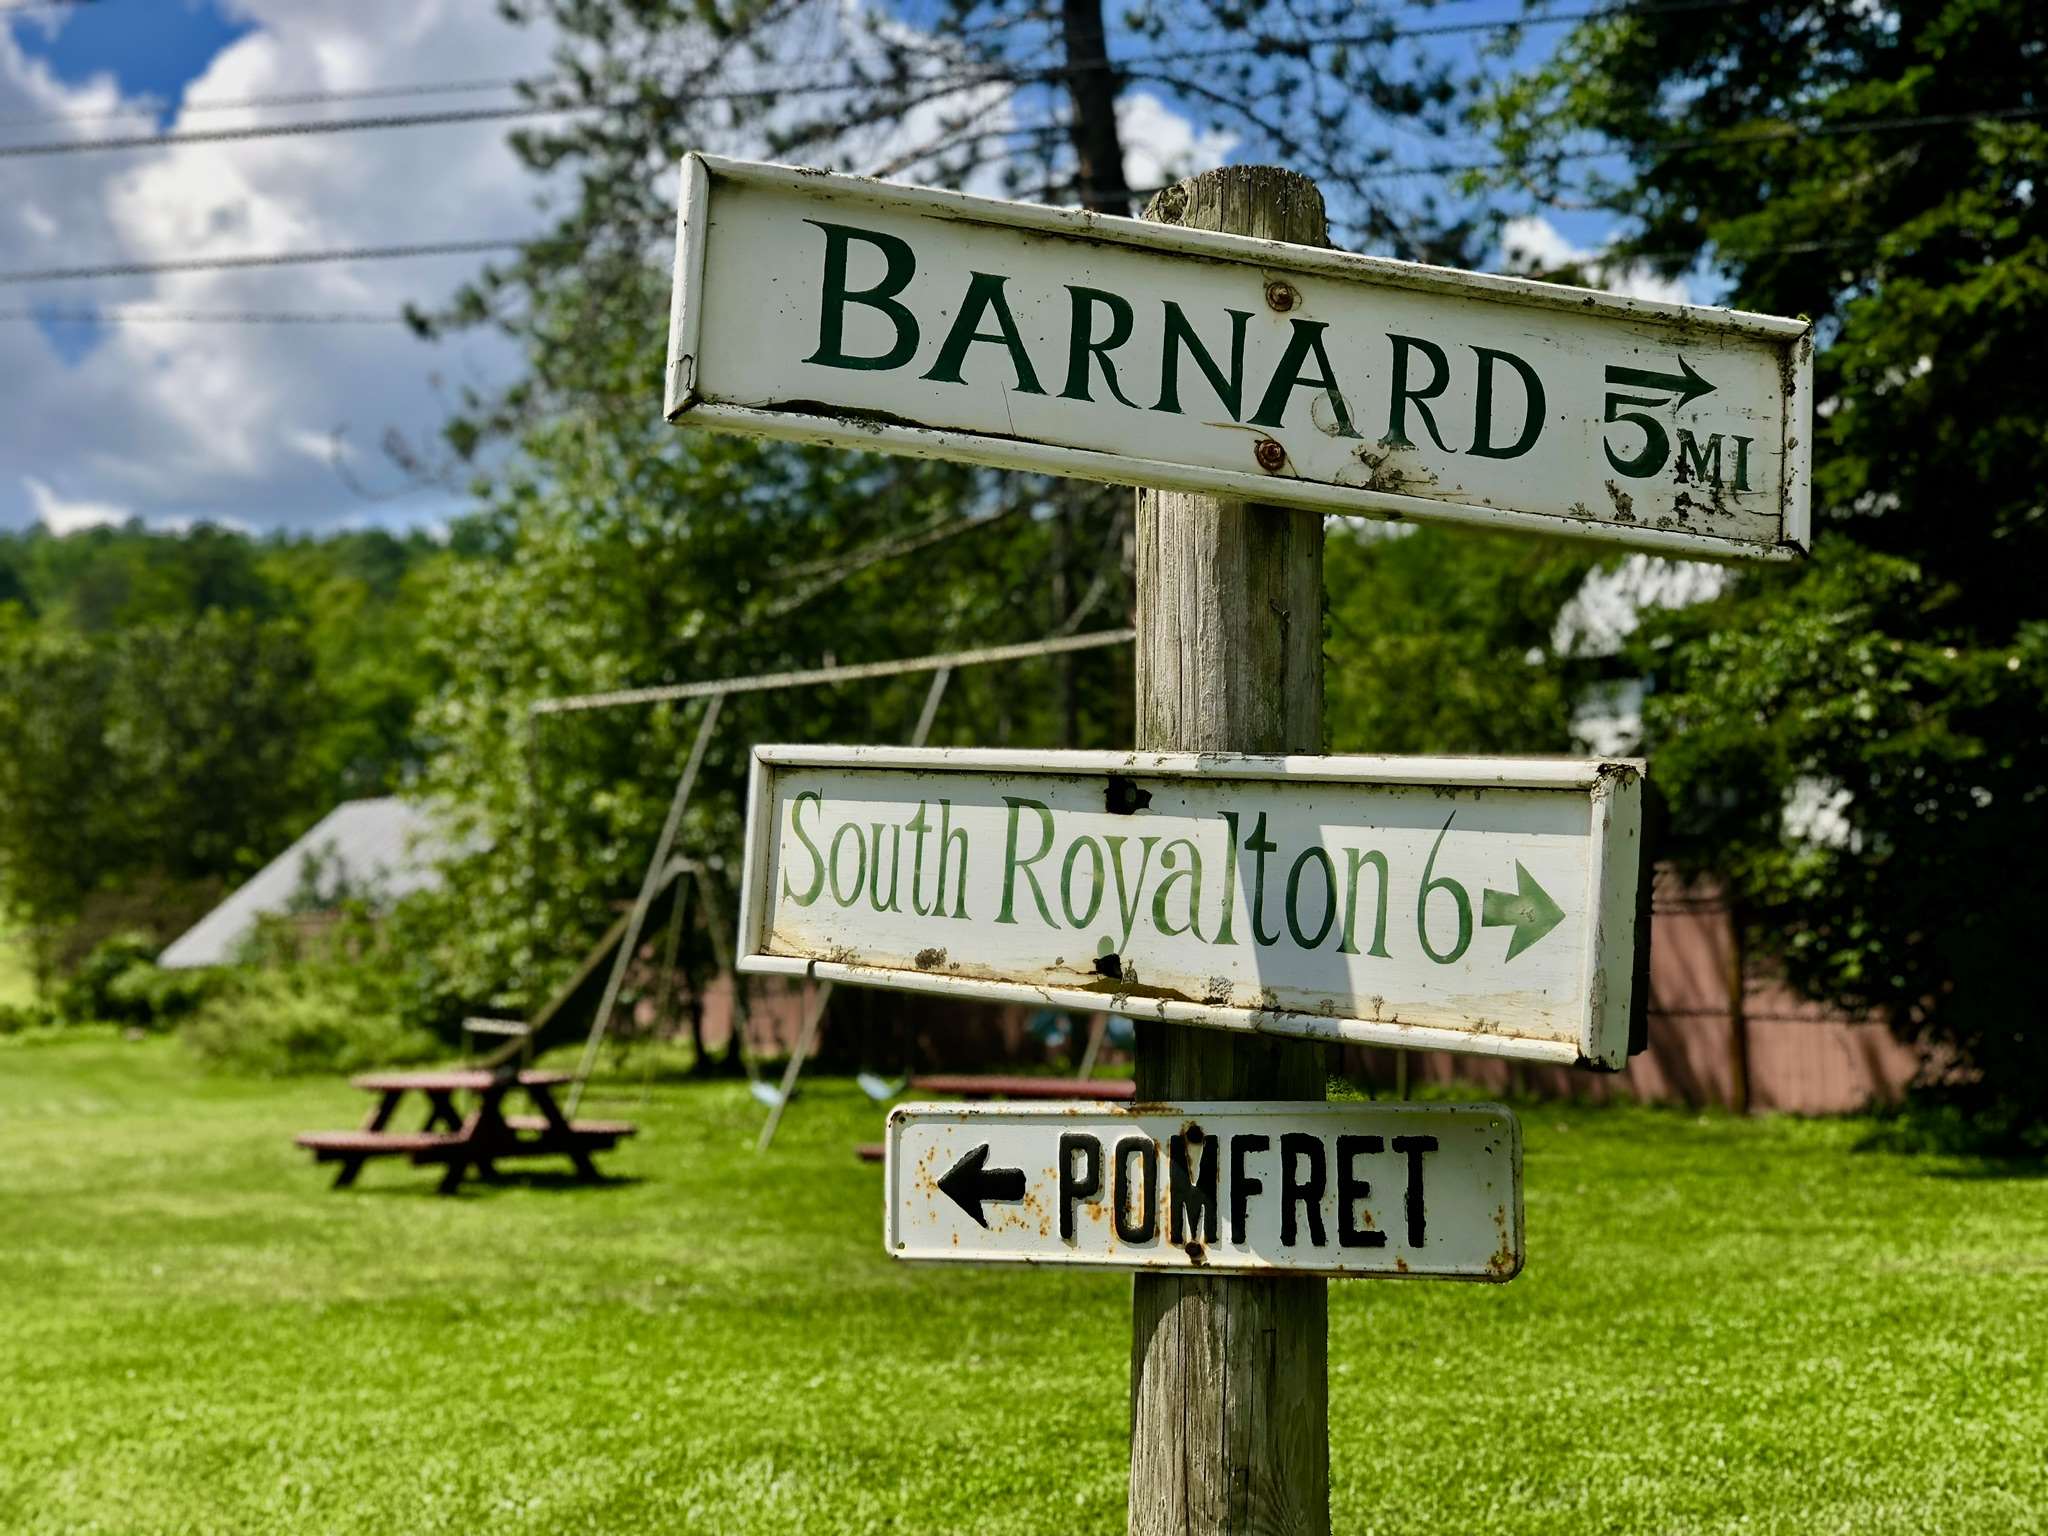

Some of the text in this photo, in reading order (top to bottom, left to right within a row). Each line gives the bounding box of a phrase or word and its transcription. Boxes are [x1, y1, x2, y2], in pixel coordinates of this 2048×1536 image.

[802, 218, 1755, 493] BARNARD 5 MI
[783, 787, 1474, 965] South Royalton 6
[1057, 1131, 1439, 1249] POMFRET
